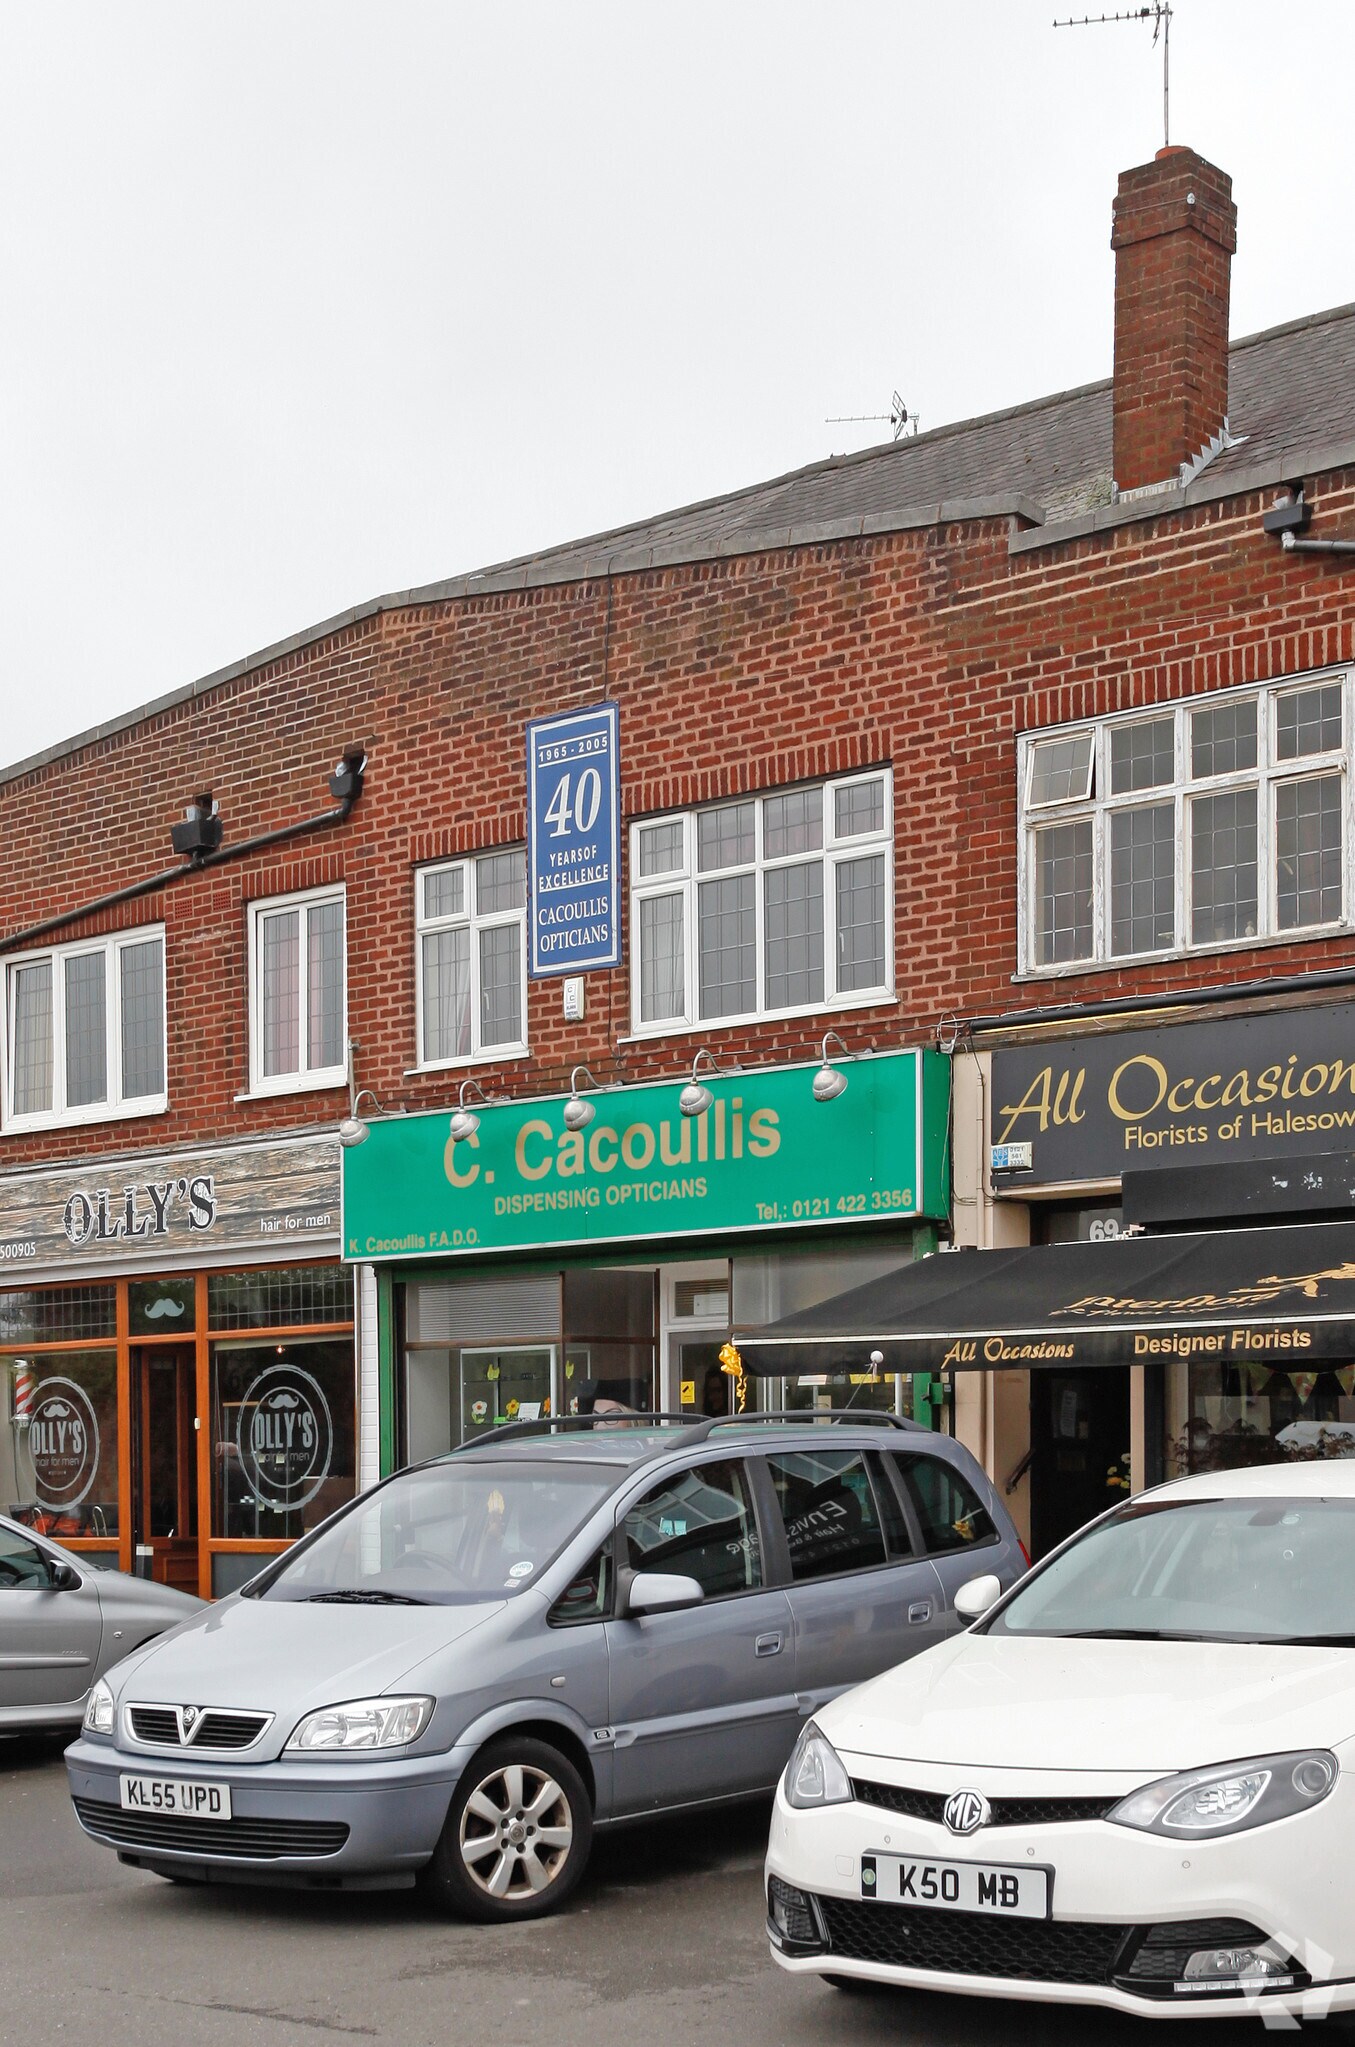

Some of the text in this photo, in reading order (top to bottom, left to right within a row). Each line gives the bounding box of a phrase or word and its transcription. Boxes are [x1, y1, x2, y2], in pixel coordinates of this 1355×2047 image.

[539, 746, 567, 762] 1965
[578, 736, 608, 753] 2005
[544, 768, 602, 838] 40
[538, 863, 609, 891] EXCELLENCE
[538, 896, 609, 926] CACOULLIS
[540, 923, 609, 952] OPTICIANS
[999, 1066, 1086, 1144] All
[444, 1097, 781, 1189] C. Cacoullis
[1124, 1123, 1208, 1150] Florists
[1217, 1114, 1244, 1140] of
[63, 1175, 218, 1246] OLLY'S
[494, 1177, 708, 1216] DISPENSING OPTICIANS
[792, 1197, 830, 1218] 0121
[836, 1194, 866, 1213] 422
[871, 1188, 912, 1209] 3356
[260, 1214, 331, 1232] hair for men
[1090, 1218, 1119, 1241] 69
[349, 1238, 362, 1254] K.
[365, 1233, 426, 1253] Cacoullis
[940, 1328, 1312, 1370] All Occasions Designer Florists
[31, 1419, 82, 1456] OLLY'S
[255, 1411, 313, 1450] OLLY'S
[127, 1779, 221, 1813] KL55 UPD
[947, 1792, 981, 1830] MG
[978, 1871, 1019, 1908] MB
